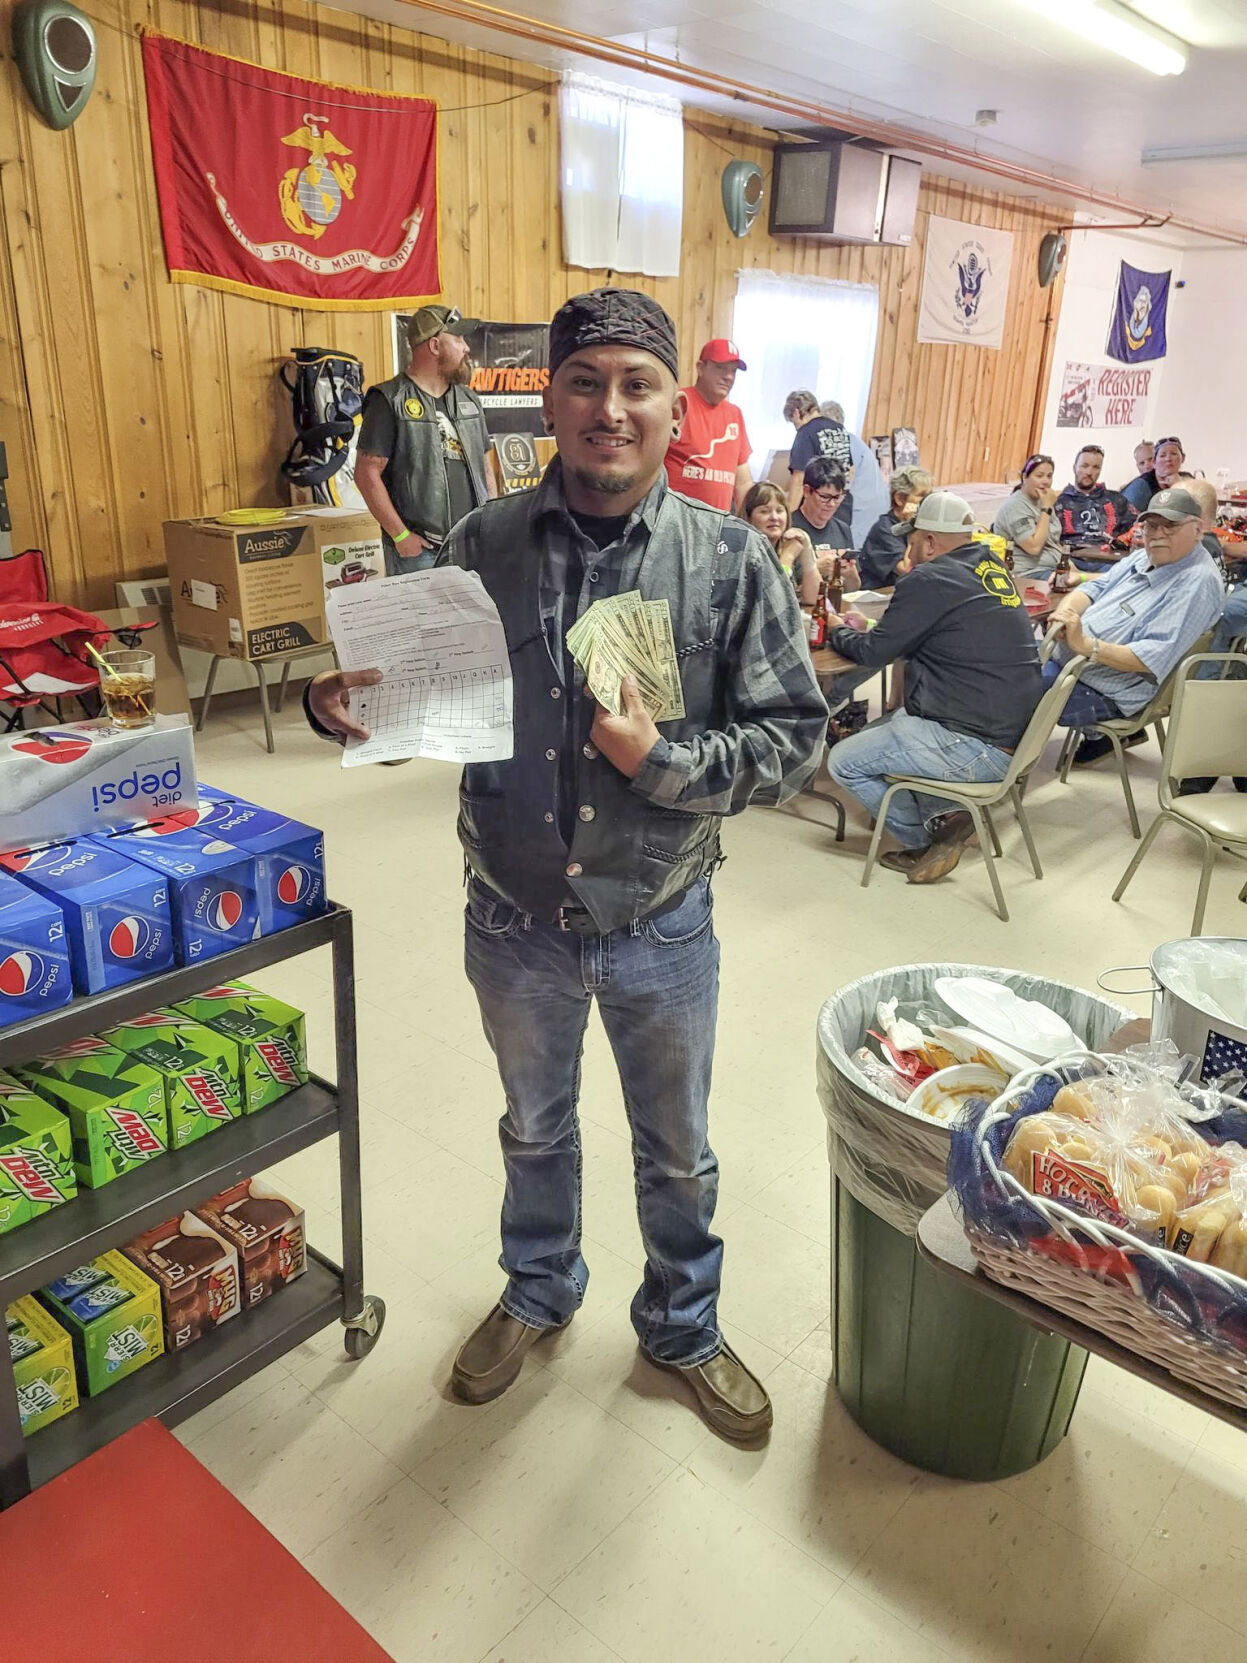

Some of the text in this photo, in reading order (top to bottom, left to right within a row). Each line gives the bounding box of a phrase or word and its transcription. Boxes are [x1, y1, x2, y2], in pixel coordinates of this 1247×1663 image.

[272, 245, 321, 271] STATES
[332, 252, 371, 271] MARINE
[379, 238, 416, 271] CORPS
[469, 367, 550, 391] AWTIGERS
[1097, 369, 1151, 396] REGISTER
[1105, 399, 1136, 425] HERE
[244, 536, 285, 553] Aussie
[252, 627, 290, 643] ELECTRIC
[252, 636, 301, 655] CART GRILL
[91, 762, 182, 812] pepsi
[152, 790, 182, 808] diet
[218, 810, 257, 830] pepsi
[48, 852, 98, 877] pepsi
[176, 862, 194, 875] 12
[153, 891, 166, 908] 12
[306, 877, 321, 906] pepsi
[193, 887, 211, 918] pepsi
[48, 925, 63, 943] 12
[144, 928, 163, 959] pepsi
[189, 938, 202, 952] 12
[39, 963, 60, 996] pepsi
[237, 1027, 254, 1036] 12
[270, 1036, 298, 1065] Mtn
[164, 1056, 183, 1069] 12
[201, 1069, 230, 1098] Mtn
[148, 1086, 162, 1108] 12
[251, 1087, 264, 1104] 12
[177, 1121, 192, 1140] 12
[113, 1130, 146, 1159] Mtn
[20, 1149, 52, 1179] Mtn
[1042, 1179, 1052, 1196] 8
[240, 1223, 256, 1239] 12
[76, 1268, 101, 1281] MIS
[166, 1264, 183, 1279] 12
[90, 1286, 124, 1304] MIST
[215, 1267, 236, 1315] MUG
[250, 1282, 264, 1303] 12
[112, 1328, 147, 1357] MIST
[176, 1324, 192, 1343] 12
[107, 1338, 131, 1362] SIERRA
[150, 1343, 159, 1356] 12
[18, 1381, 59, 1411] MIST
[62, 1397, 72, 1410] 12
